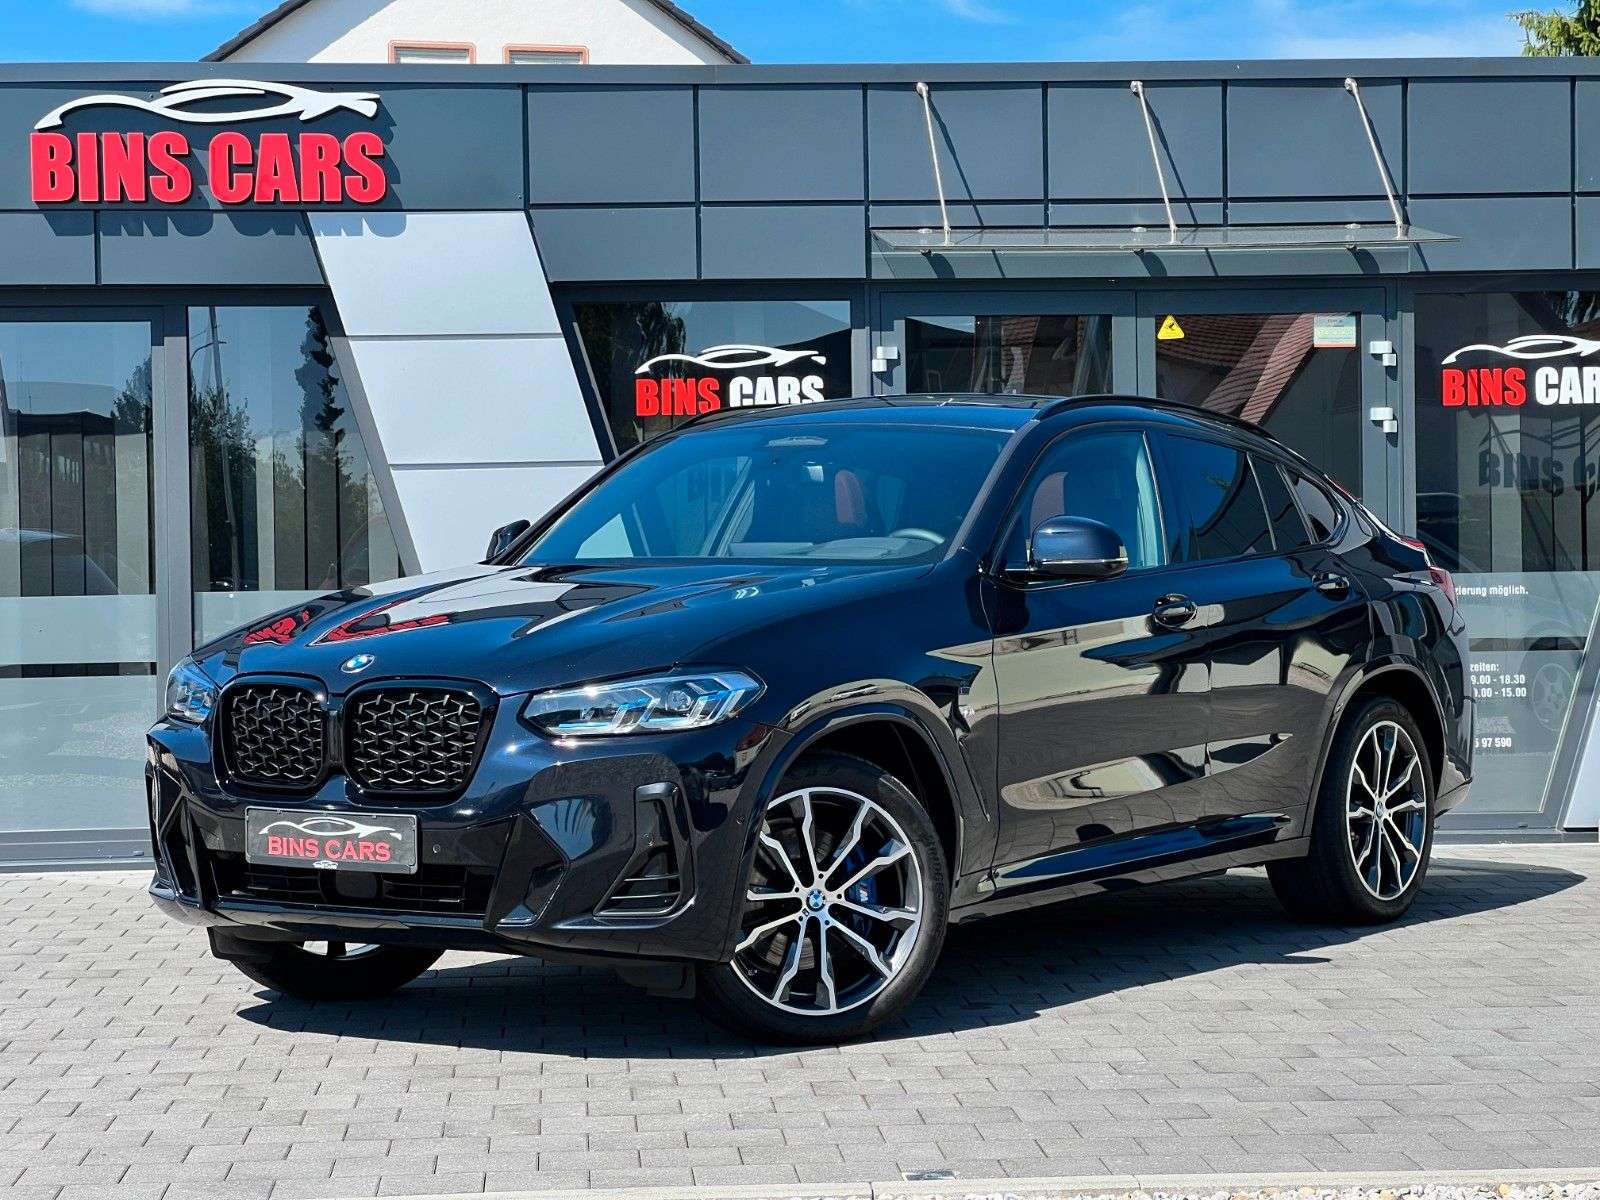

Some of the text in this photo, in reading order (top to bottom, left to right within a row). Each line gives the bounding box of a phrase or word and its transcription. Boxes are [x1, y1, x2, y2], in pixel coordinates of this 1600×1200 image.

[30, 131, 386, 202] BINS CARS
[635, 375, 825, 416] BINS CARS
[1442, 366, 1600, 406] BINS CAR
[1489, 585, 1529, 597] möglich.
[1471, 674, 1491, 685] 9.00
[1501, 687, 1527, 698] 15.00
[267, 836, 391, 862] BINS CARS
